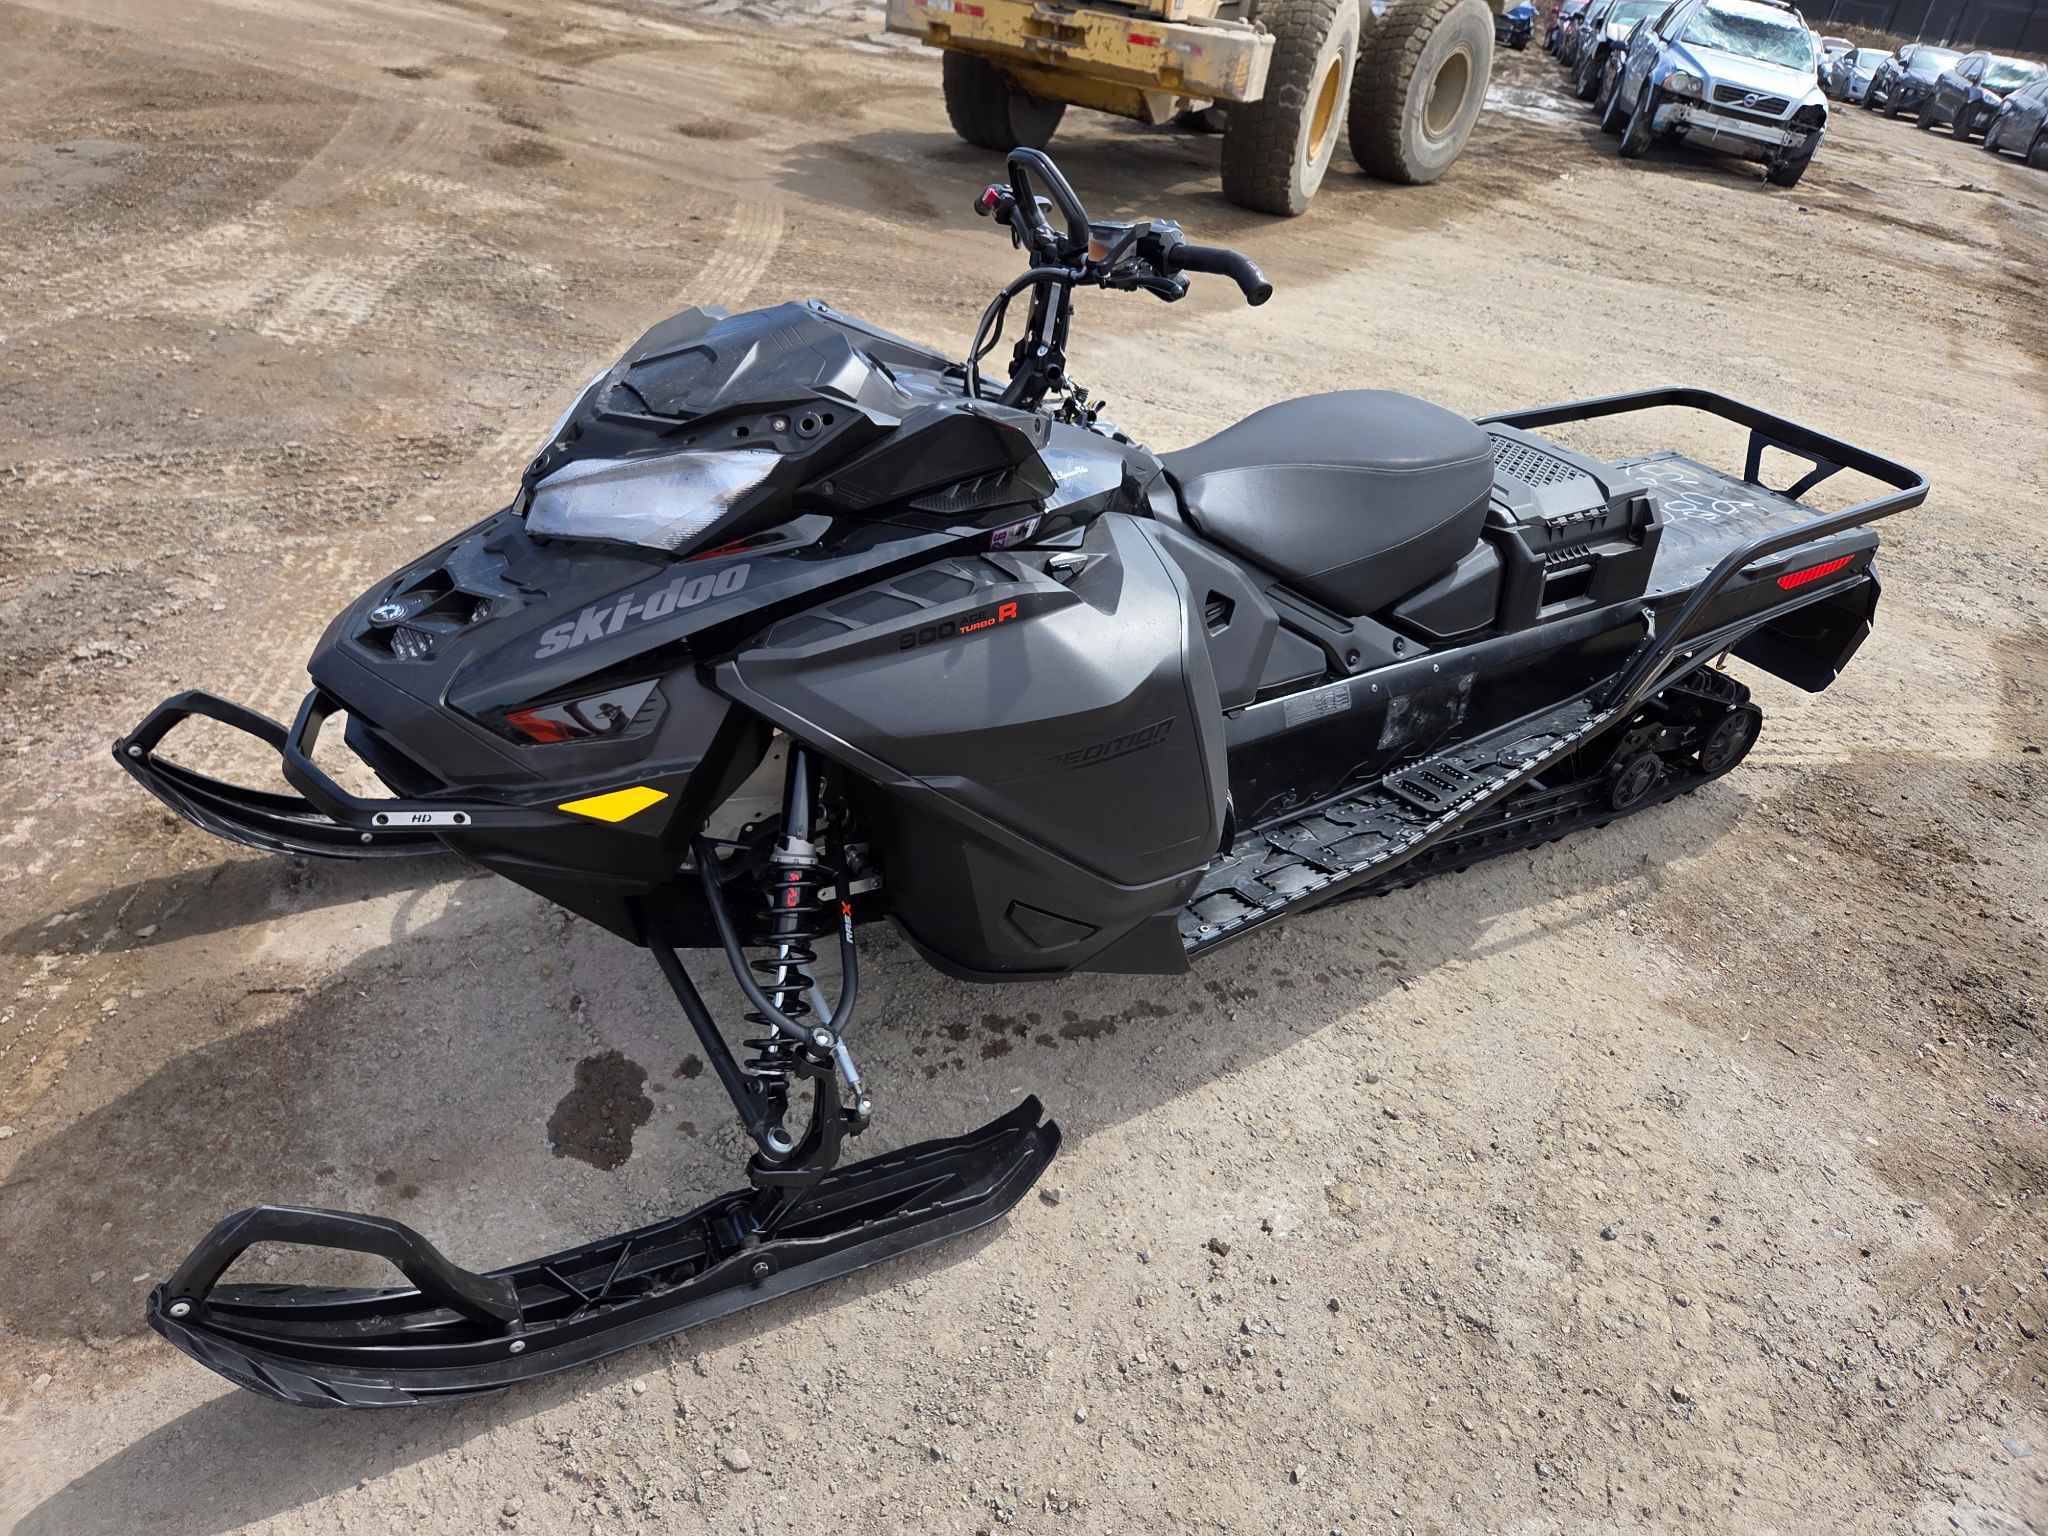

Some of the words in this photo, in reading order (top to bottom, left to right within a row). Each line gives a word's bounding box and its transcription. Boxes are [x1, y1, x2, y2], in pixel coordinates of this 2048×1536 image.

[960, 618, 996, 634] TURBO
[998, 602, 1017, 624] R
[411, 814, 432, 823] HD
